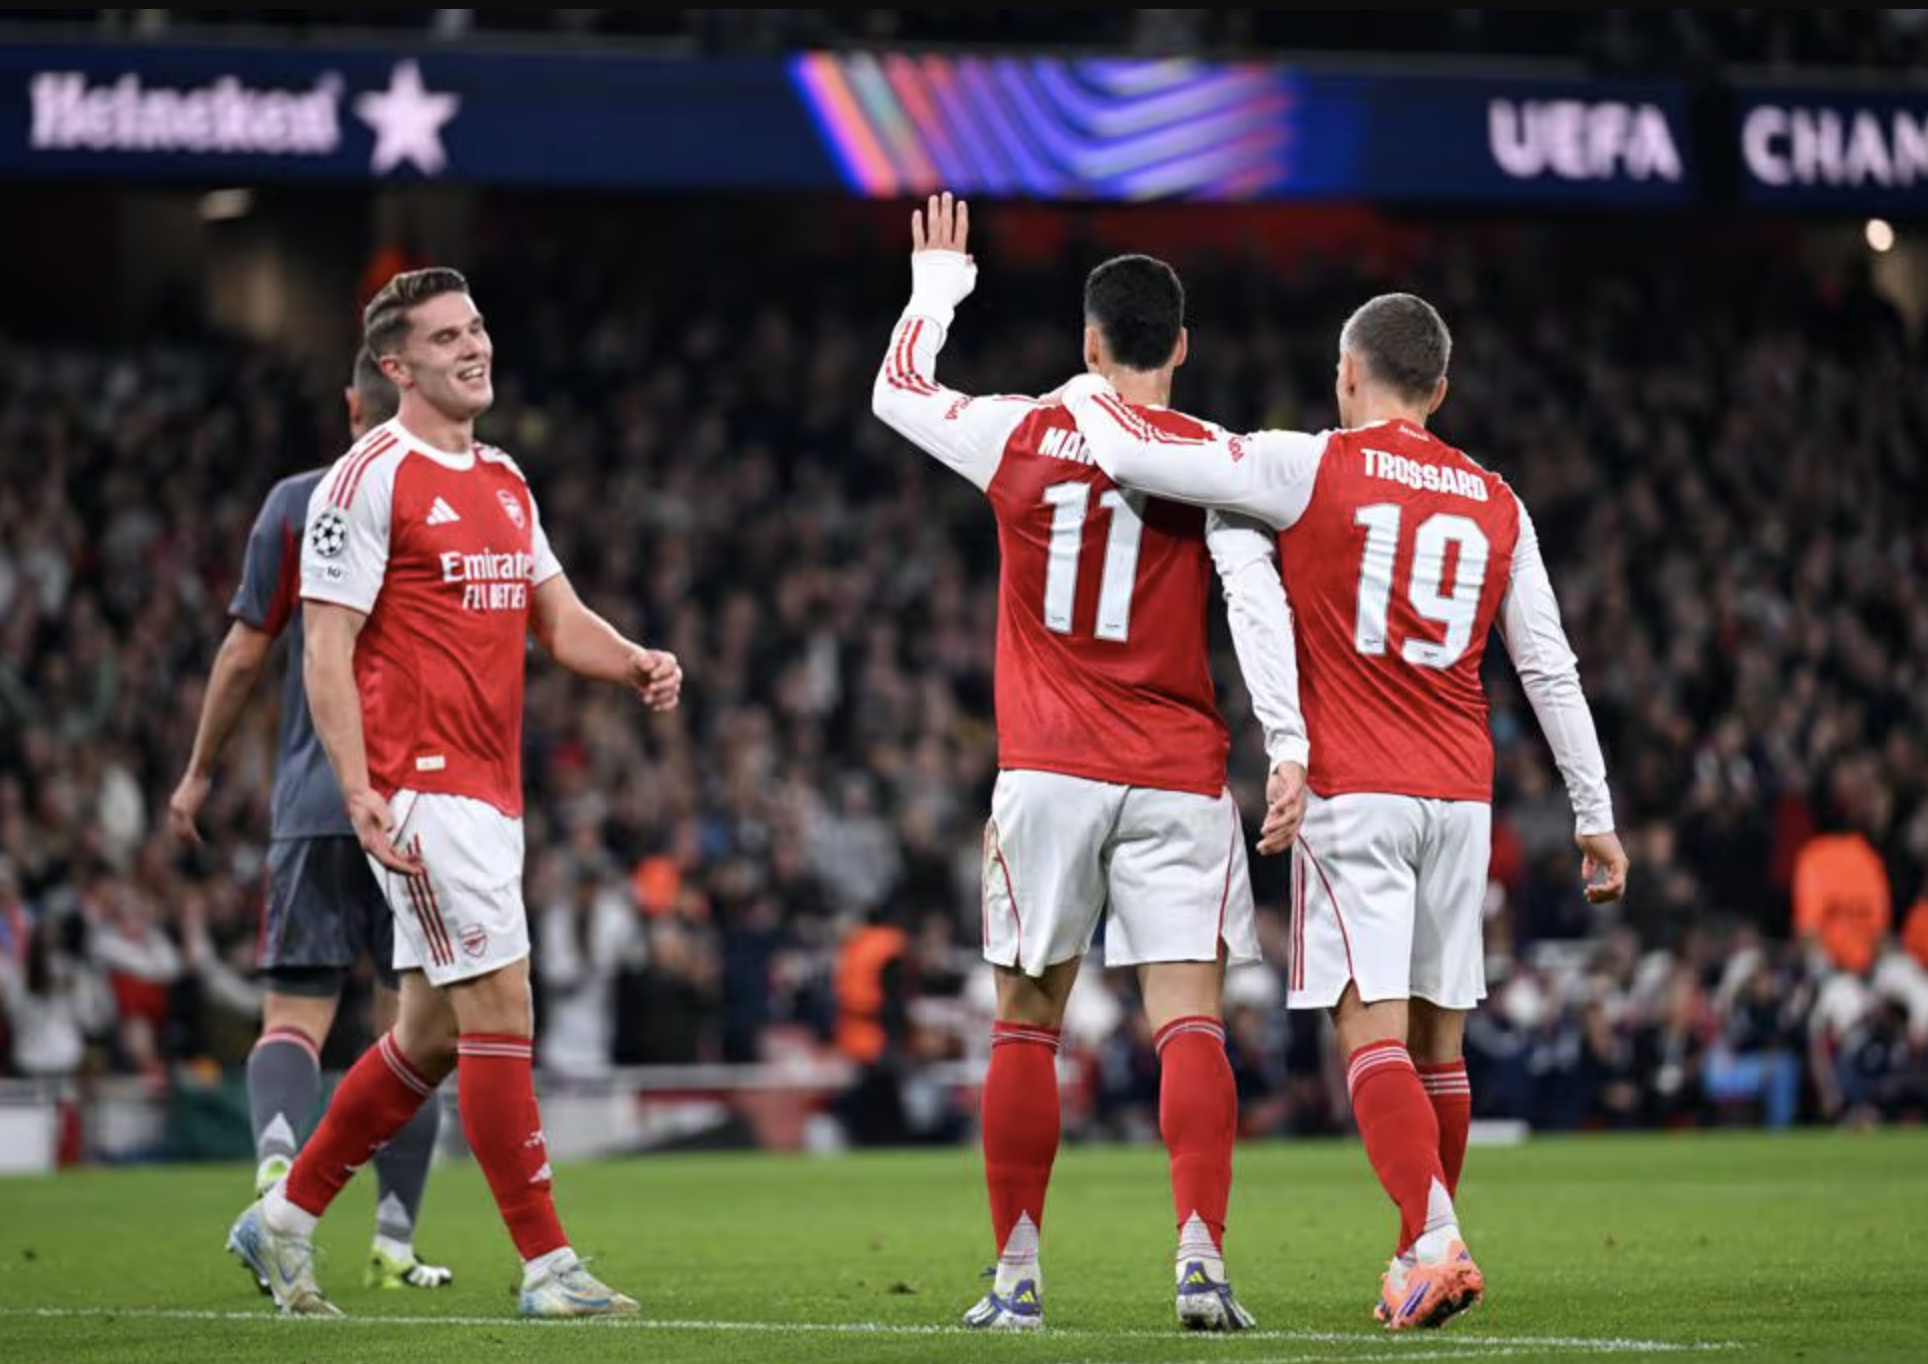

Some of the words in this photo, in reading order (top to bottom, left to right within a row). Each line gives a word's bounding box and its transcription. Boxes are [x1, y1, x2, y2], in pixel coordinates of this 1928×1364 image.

[1489, 99, 1680, 179] UEFA
[1361, 448, 1488, 502] TROSSARD
[440, 547, 534, 583] Emirate
[1042, 481, 1143, 643] 11
[1353, 503, 1490, 671] 19
